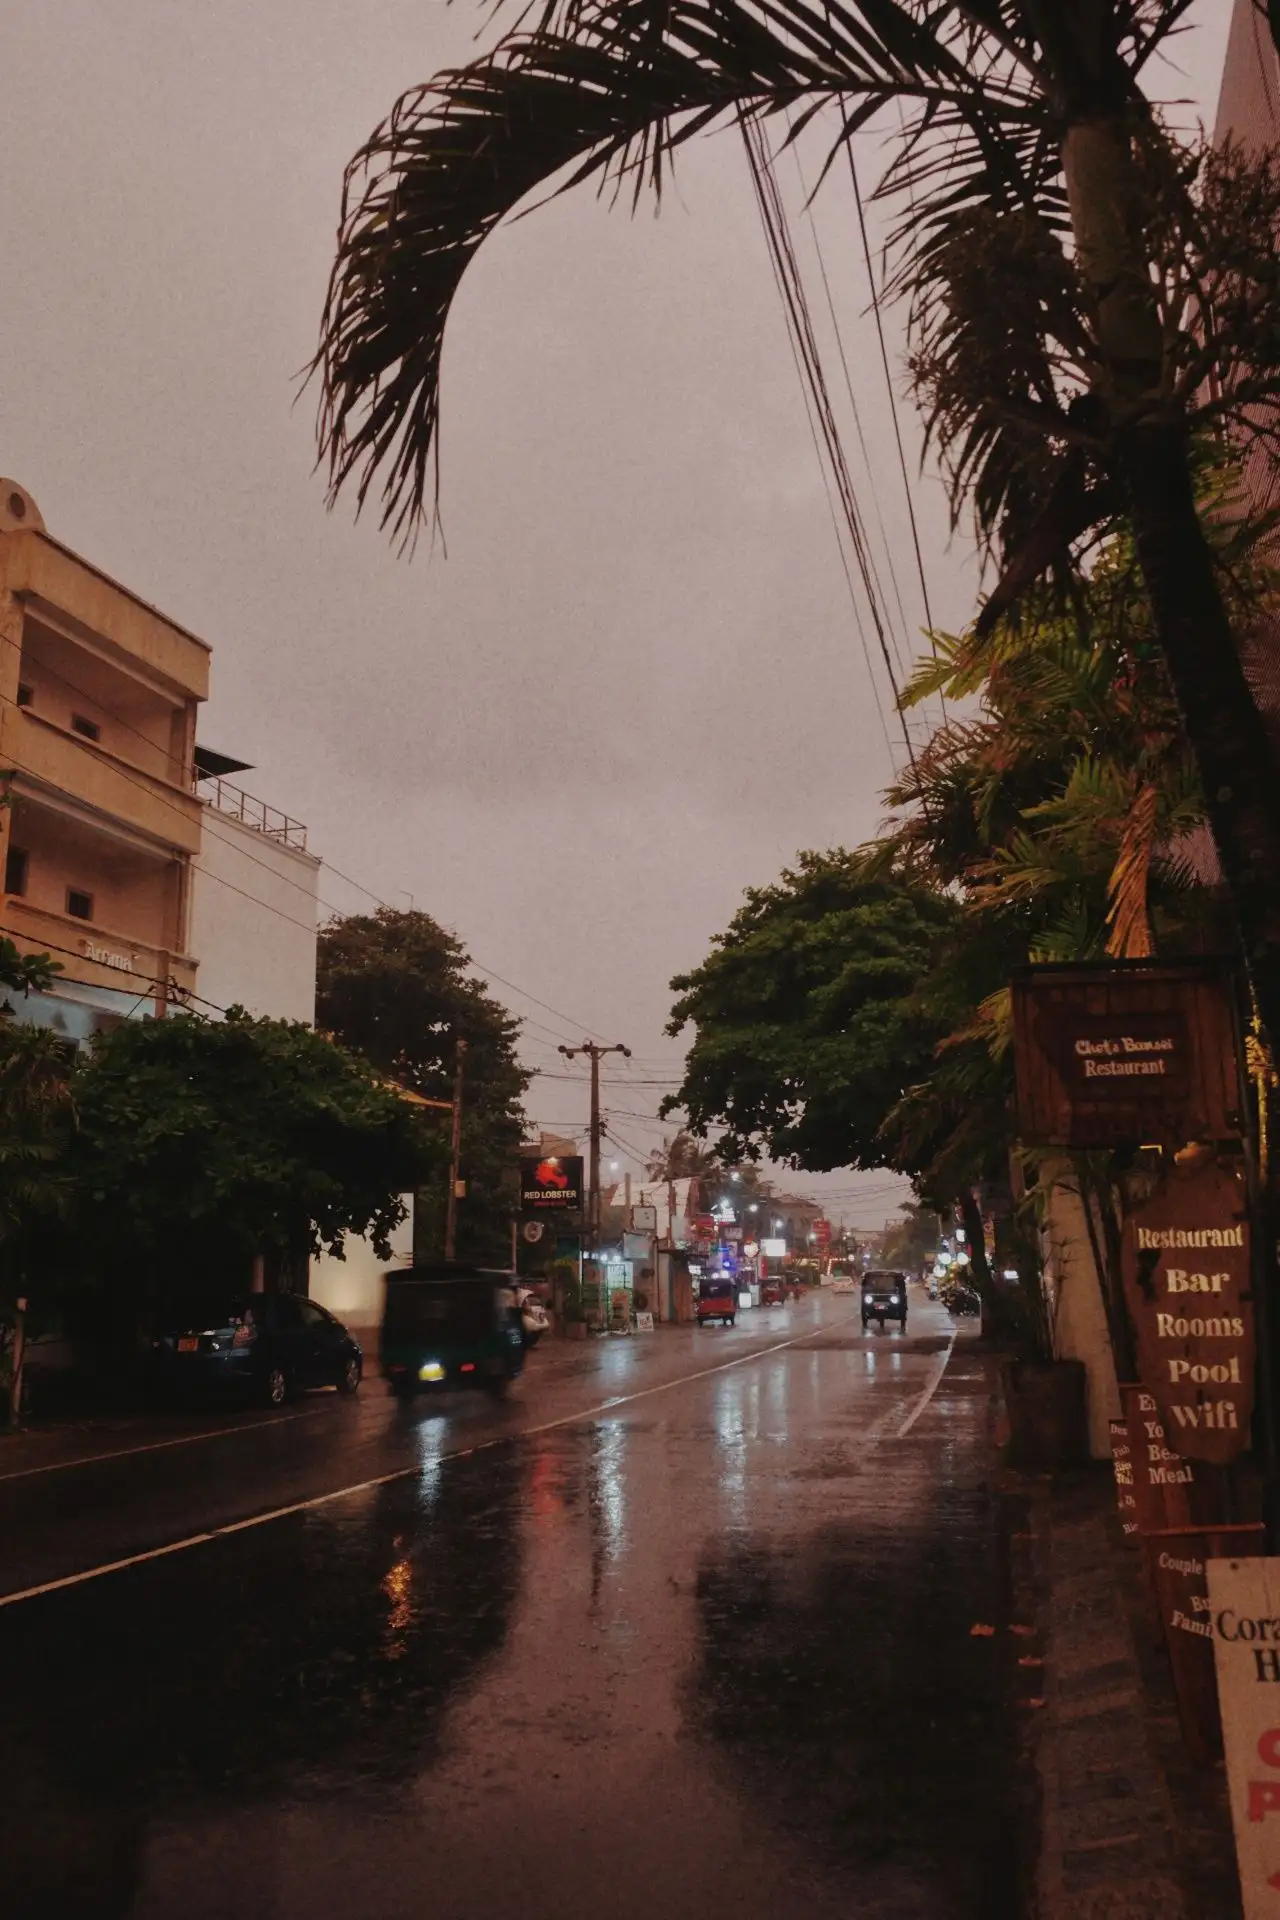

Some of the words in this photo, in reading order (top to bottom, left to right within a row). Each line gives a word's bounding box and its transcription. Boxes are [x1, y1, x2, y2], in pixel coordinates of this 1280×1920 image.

[1084, 1058, 1166, 1077] Restaurant
[524, 1191, 541, 1199] RED
[541, 1190, 577, 1199] LOBSTER
[1138, 1223, 1244, 1249] Restaurant
[1165, 1268, 1231, 1293] Bar
[1156, 1312, 1245, 1338] Rooms
[1167, 1354, 1243, 1385] Pool
[1168, 1400, 1238, 1430] Wifi
[1148, 1464, 1195, 1485] Meal
